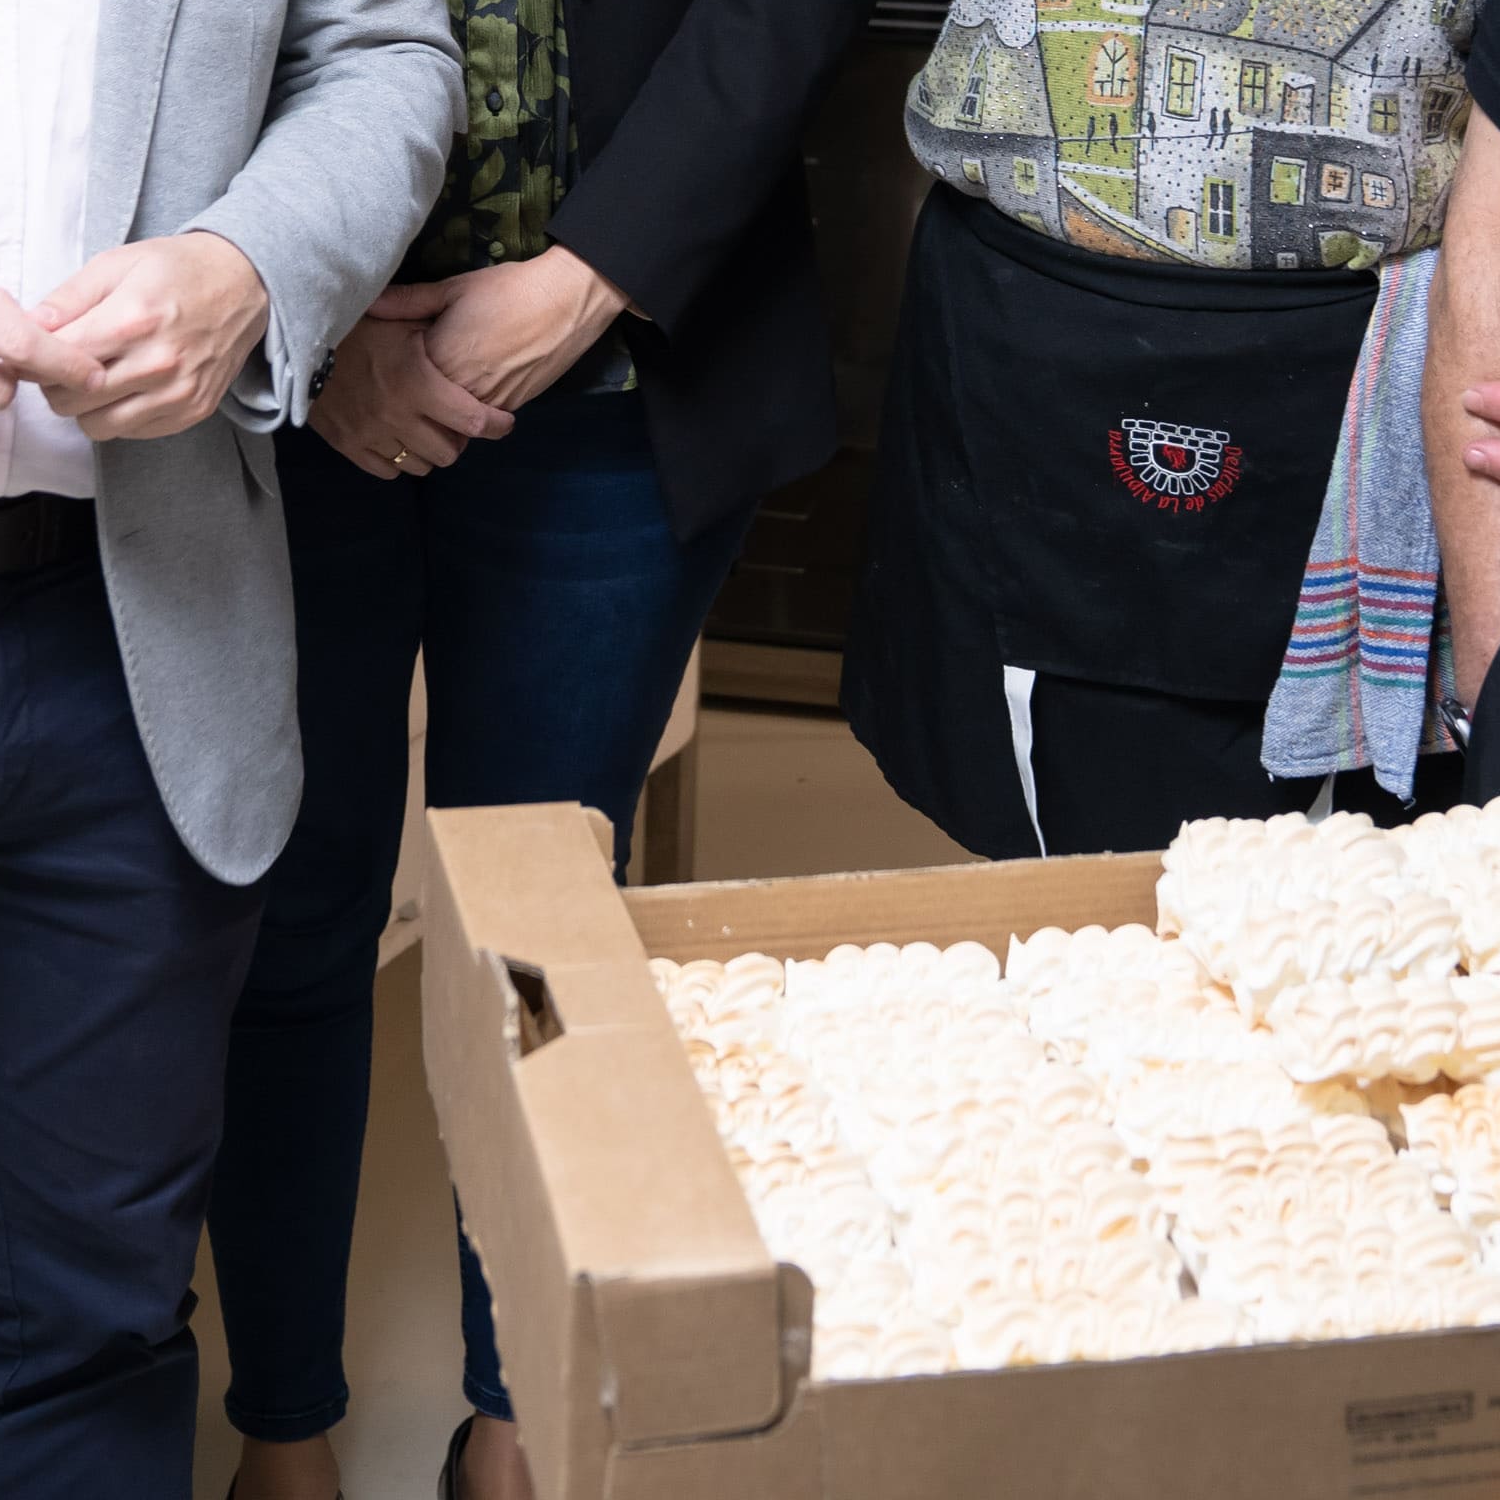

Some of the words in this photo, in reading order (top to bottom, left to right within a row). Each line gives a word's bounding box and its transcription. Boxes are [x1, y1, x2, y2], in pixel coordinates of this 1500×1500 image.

[1207, 446, 1243, 502] Delicias
[1157, 496, 1179, 513] La
[1186, 496, 1205, 512] de
